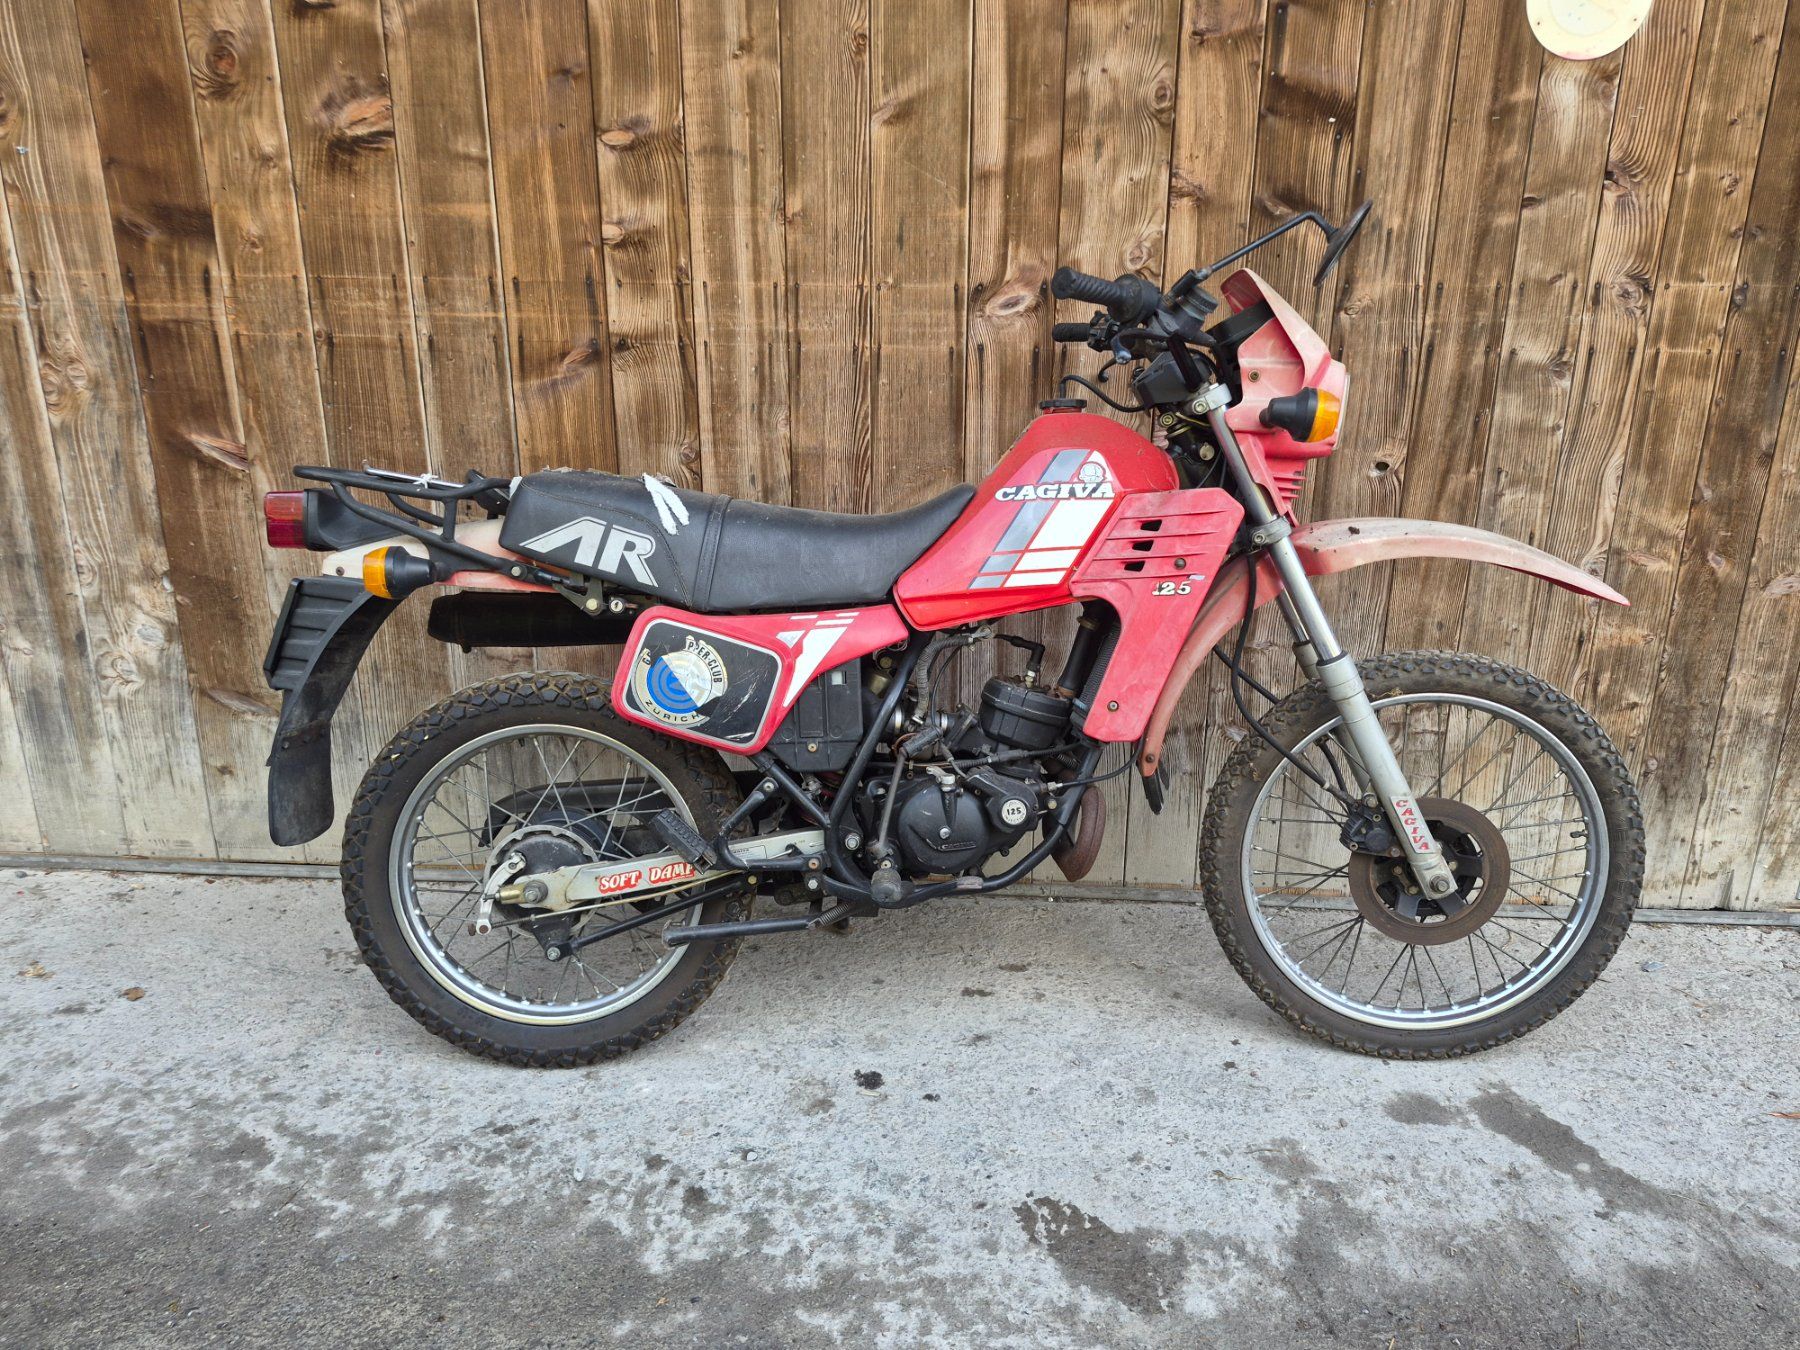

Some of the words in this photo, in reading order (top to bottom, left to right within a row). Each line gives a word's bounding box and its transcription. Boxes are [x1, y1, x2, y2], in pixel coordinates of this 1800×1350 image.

[994, 481, 1115, 502] CAGIVA
[1007, 807, 1022, 816] 125
[1395, 799, 1430, 851] CAGIVA
[600, 870, 640, 891] SOFT
